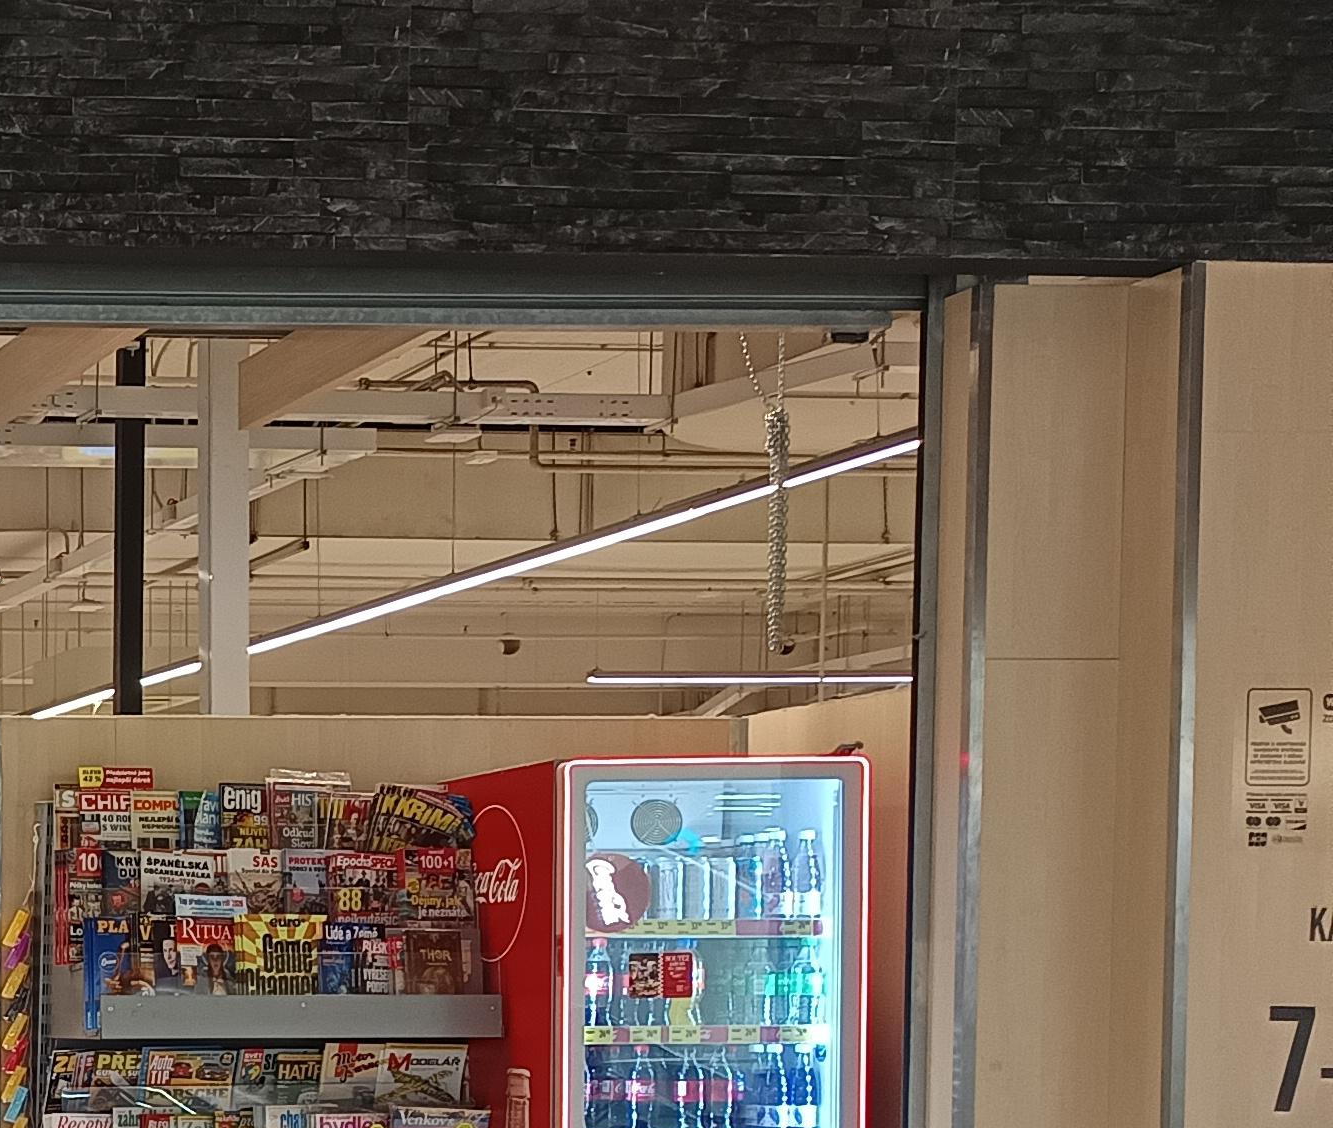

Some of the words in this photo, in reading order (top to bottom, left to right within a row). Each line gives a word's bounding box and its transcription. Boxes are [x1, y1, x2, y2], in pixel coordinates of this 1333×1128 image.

[252, 856, 278, 868] SAS
[338, 888, 362, 911] 88
[1309, 907, 1333, 942] K
